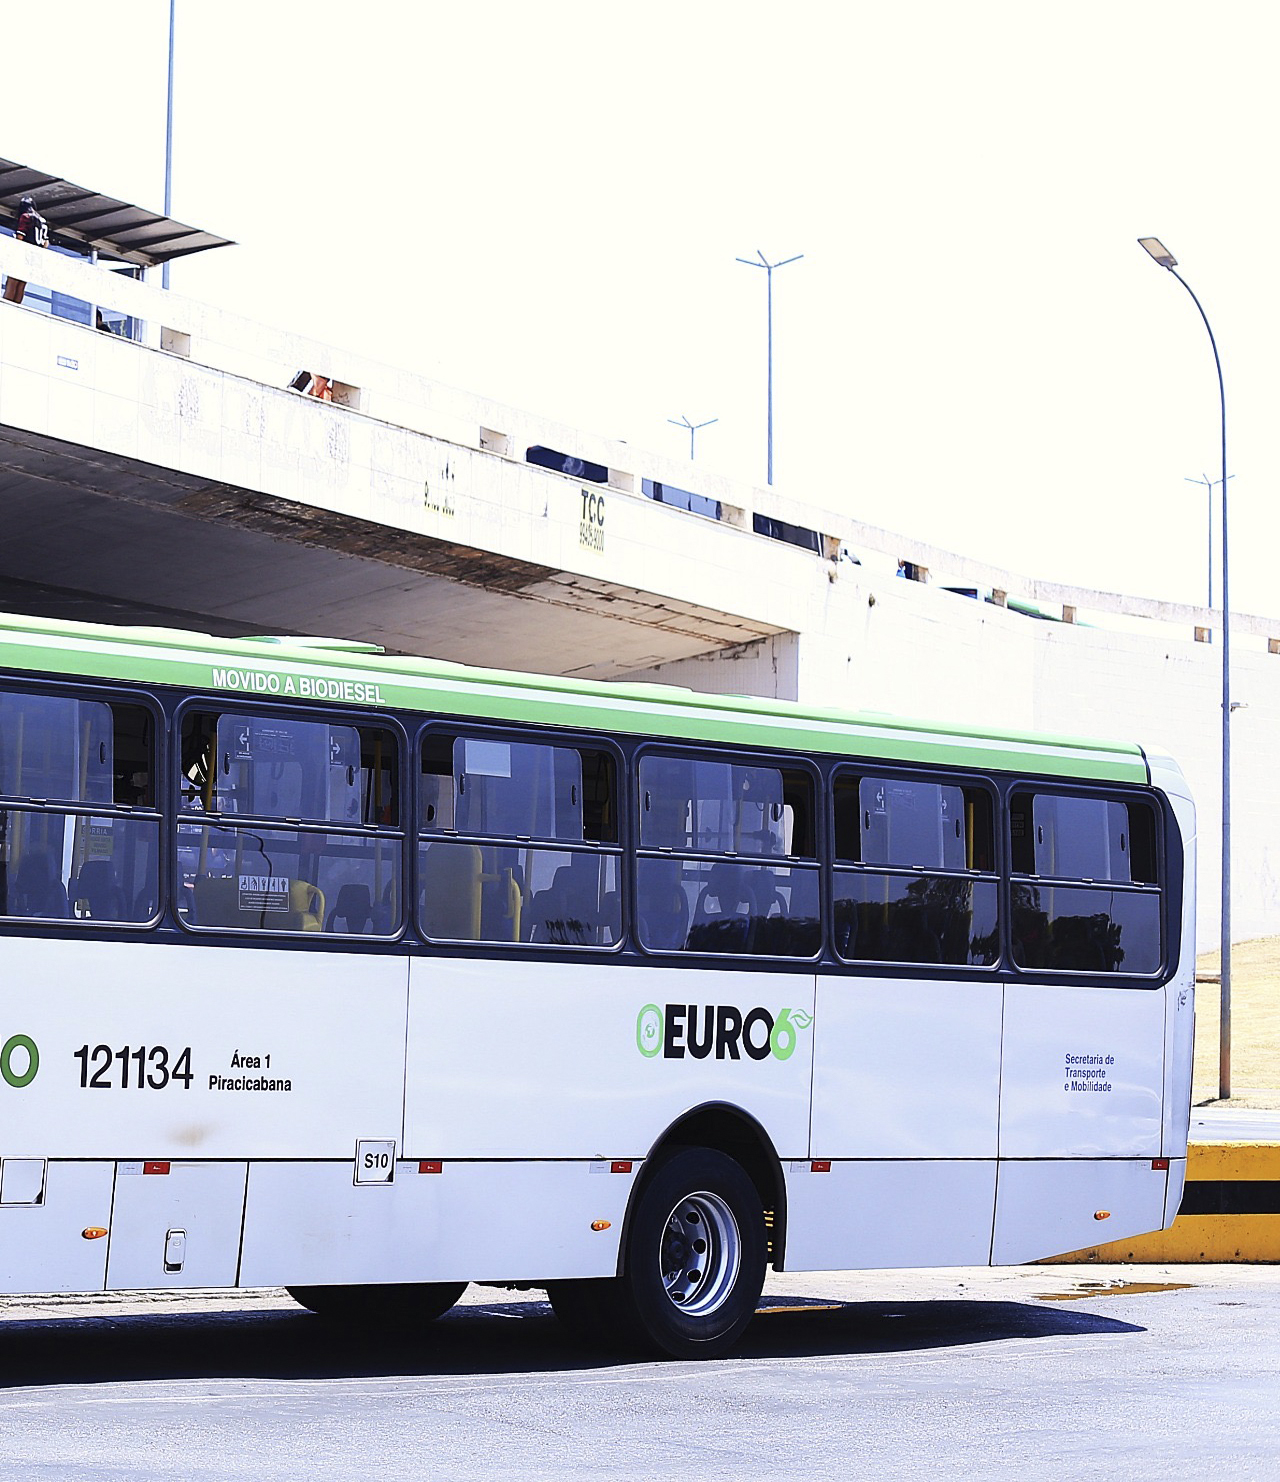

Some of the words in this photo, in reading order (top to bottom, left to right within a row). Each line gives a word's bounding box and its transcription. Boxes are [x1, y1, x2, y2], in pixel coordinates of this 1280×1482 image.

[581, 489, 605, 527] TCC
[212, 668, 280, 694] MOVIDO
[283, 675, 297, 695] A
[299, 677, 386, 704] BIODIESEL
[73, 1044, 194, 1090] 121134
[230, 1049, 261, 1069] Área
[264, 1054, 271, 1069] 1
[1065, 1053, 1103, 1065] Secretaria
[1105, 1054, 1115, 1065] de
[1065, 1067, 1106, 1080] Transporte
[209, 1075, 292, 1092] Piracicabana
[1064, 1083, 1069, 1091] e
[1071, 1080, 1112, 1092] Mobilidade
[364, 1152, 389, 1169] S10
